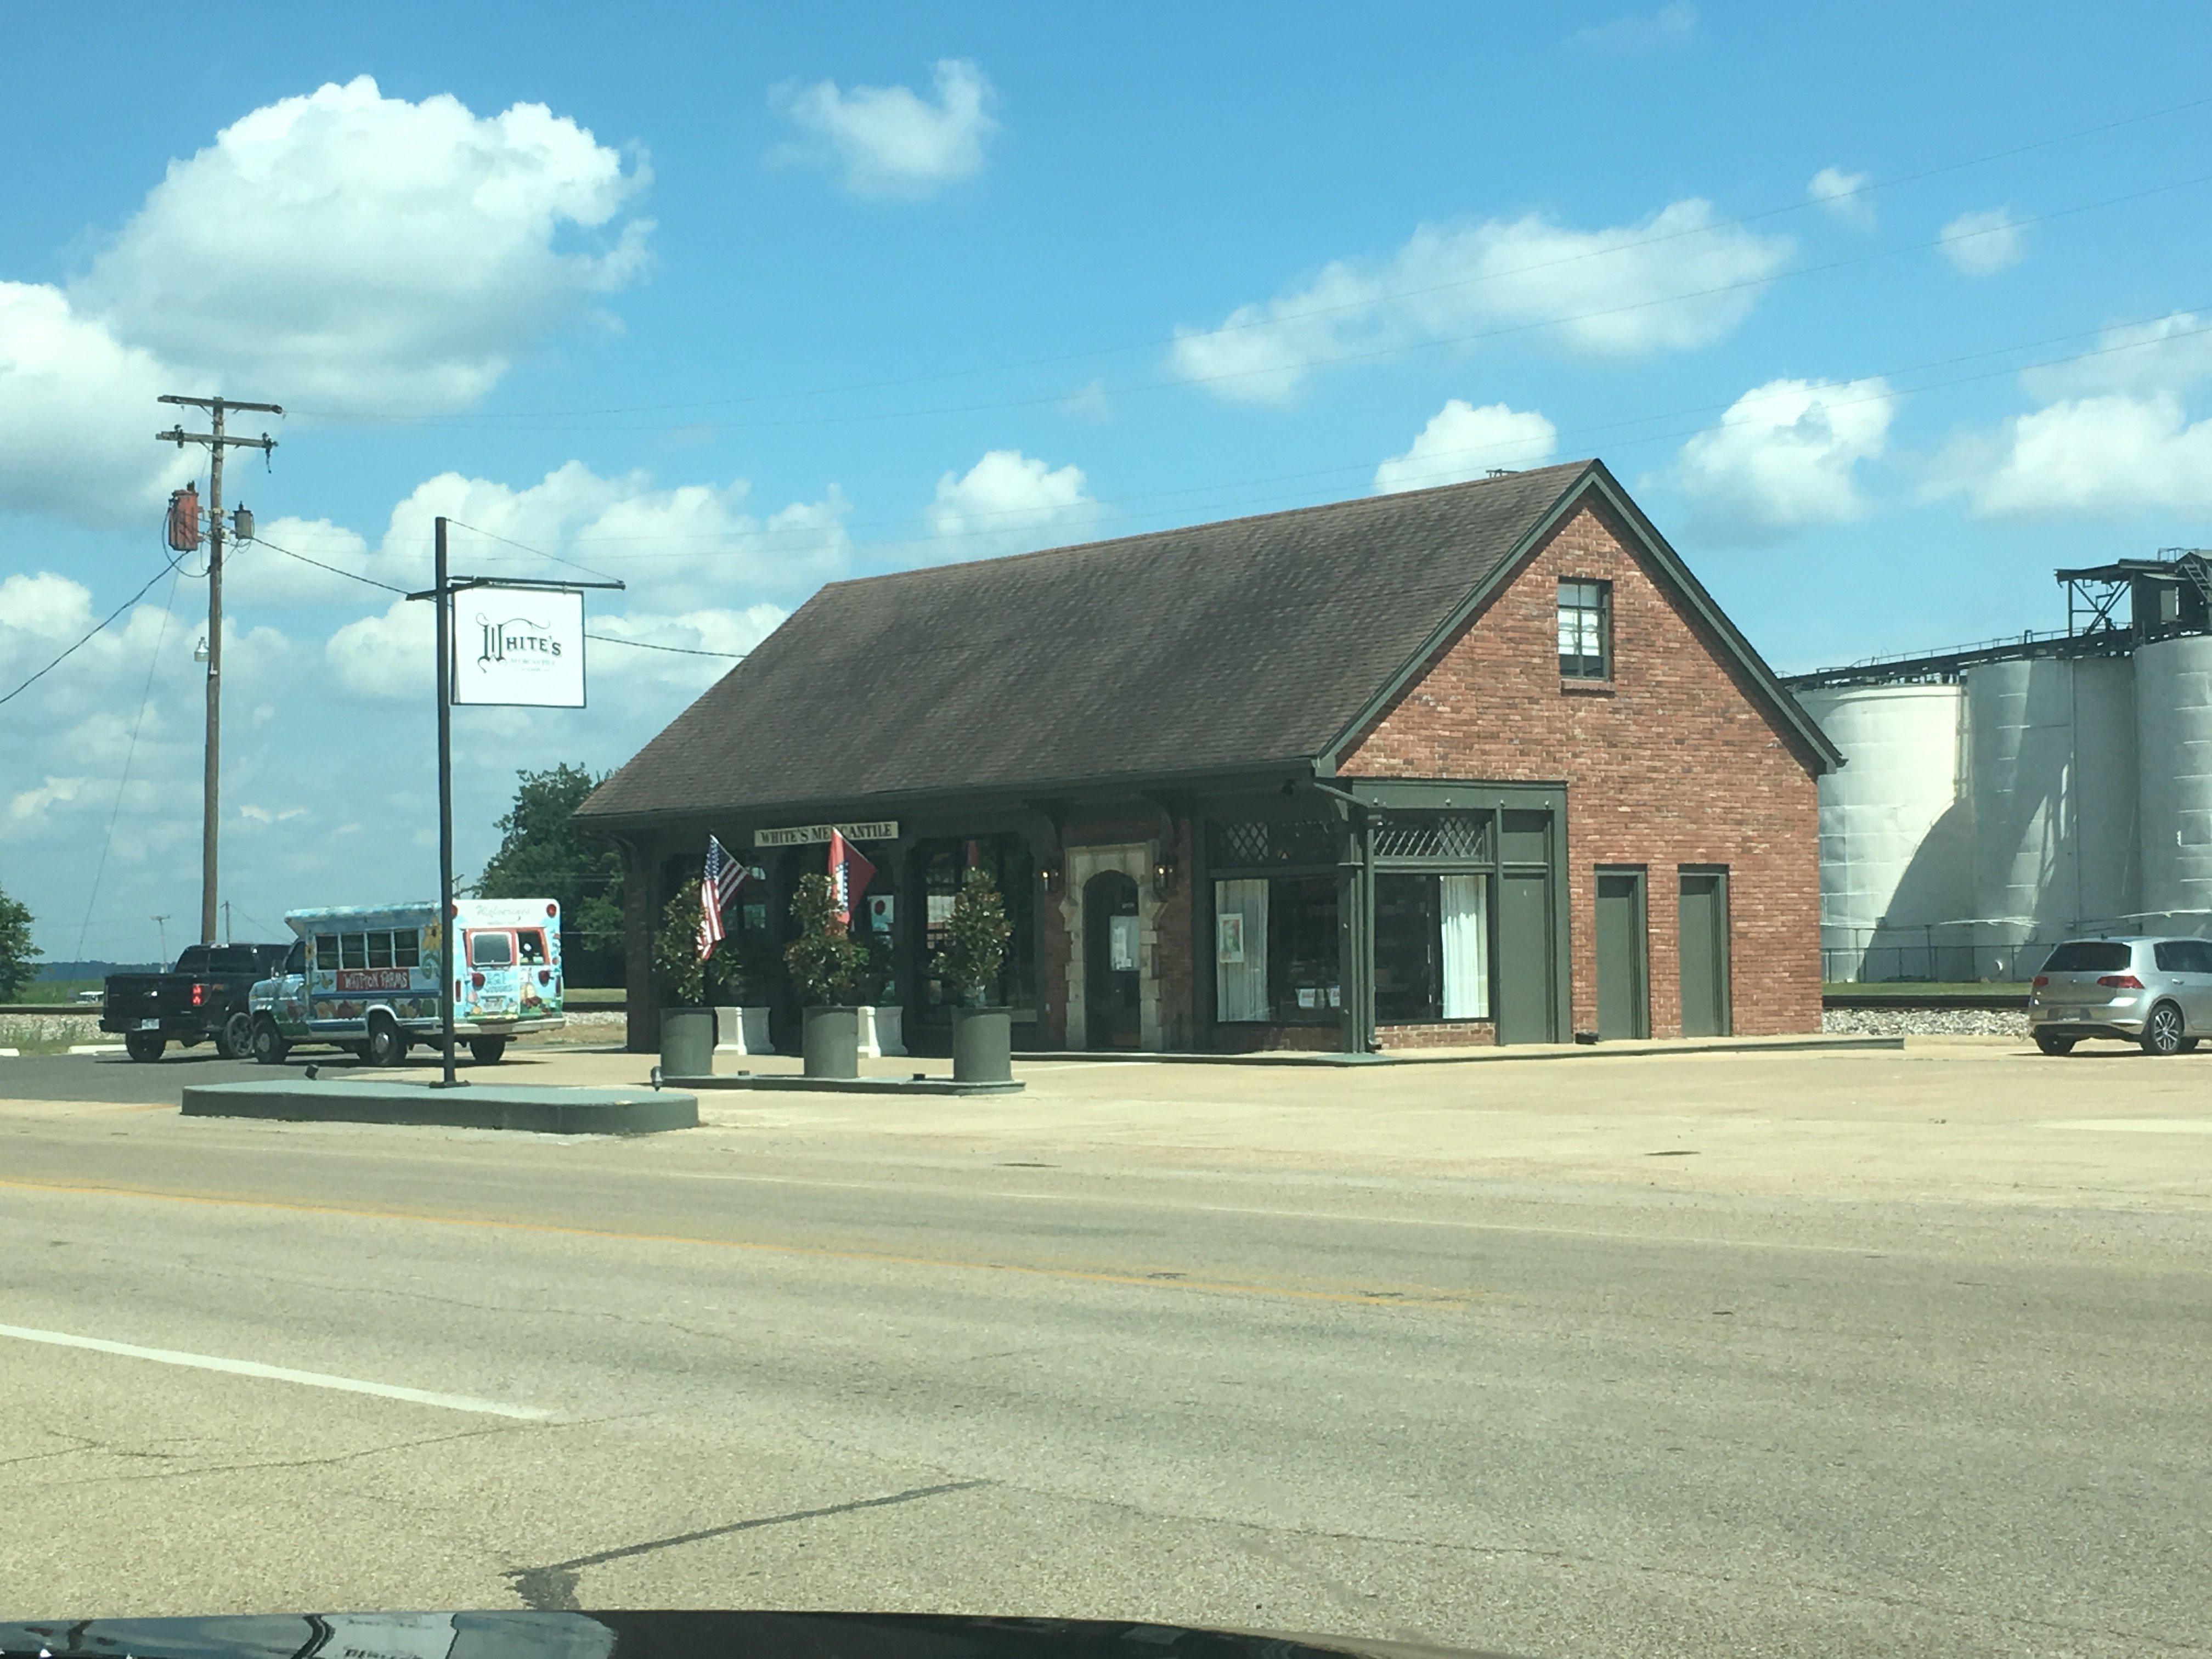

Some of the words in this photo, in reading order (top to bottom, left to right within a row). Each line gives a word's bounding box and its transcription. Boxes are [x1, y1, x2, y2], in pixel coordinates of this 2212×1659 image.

[476, 613, 561, 673] WHITE'S
[760, 827, 809, 843] WHITE'S
[811, 823, 892, 842] MECANTILE
